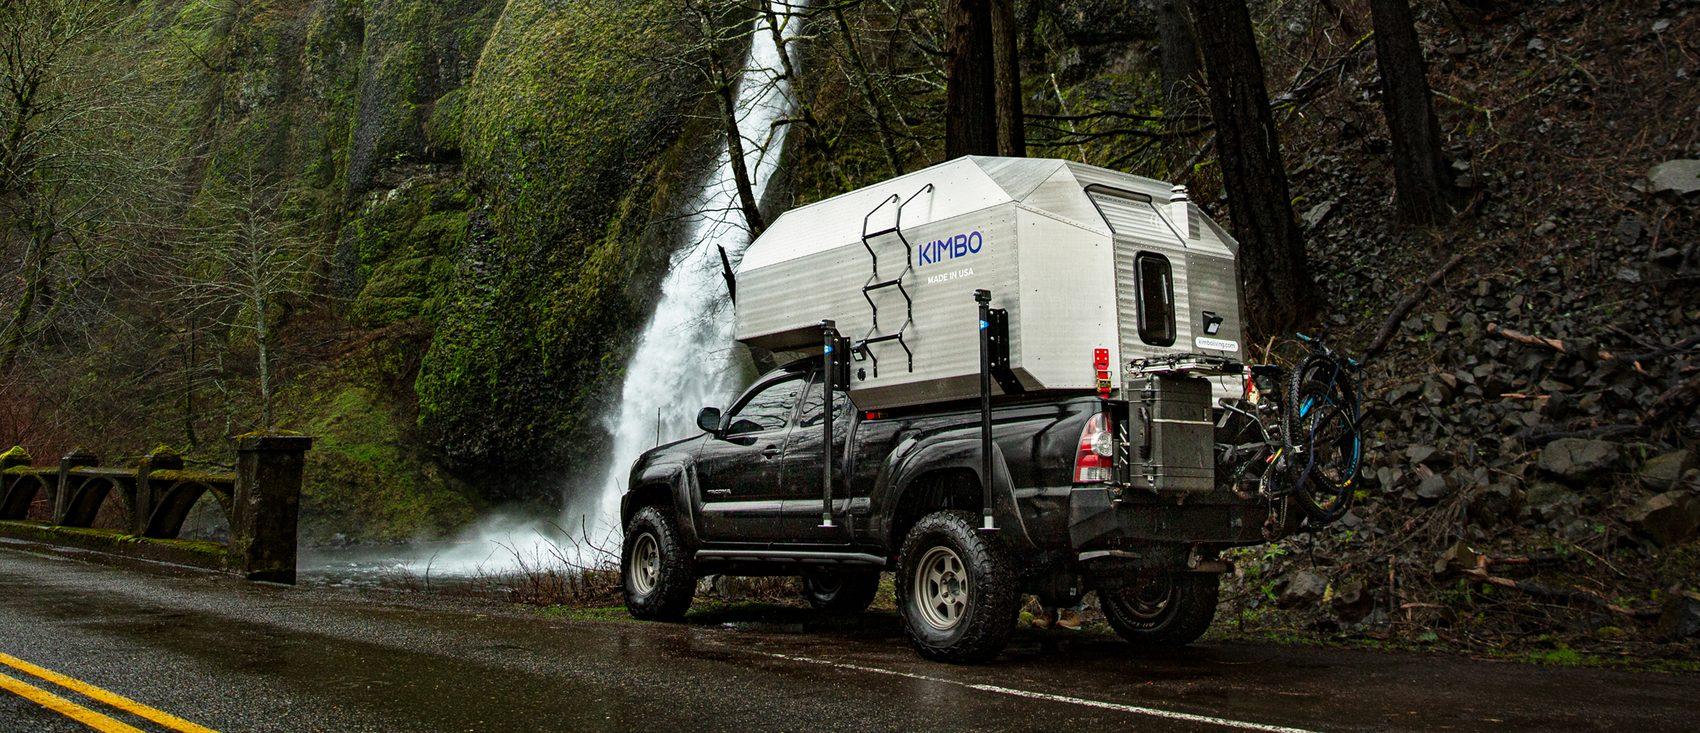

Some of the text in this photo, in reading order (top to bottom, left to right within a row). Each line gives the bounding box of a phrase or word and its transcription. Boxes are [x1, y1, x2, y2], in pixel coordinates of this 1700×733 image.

[919, 231, 982, 266] KIMBO
[927, 267, 974, 285] MADE IN USA
[1198, 339, 1236, 349] kimboliving.com
